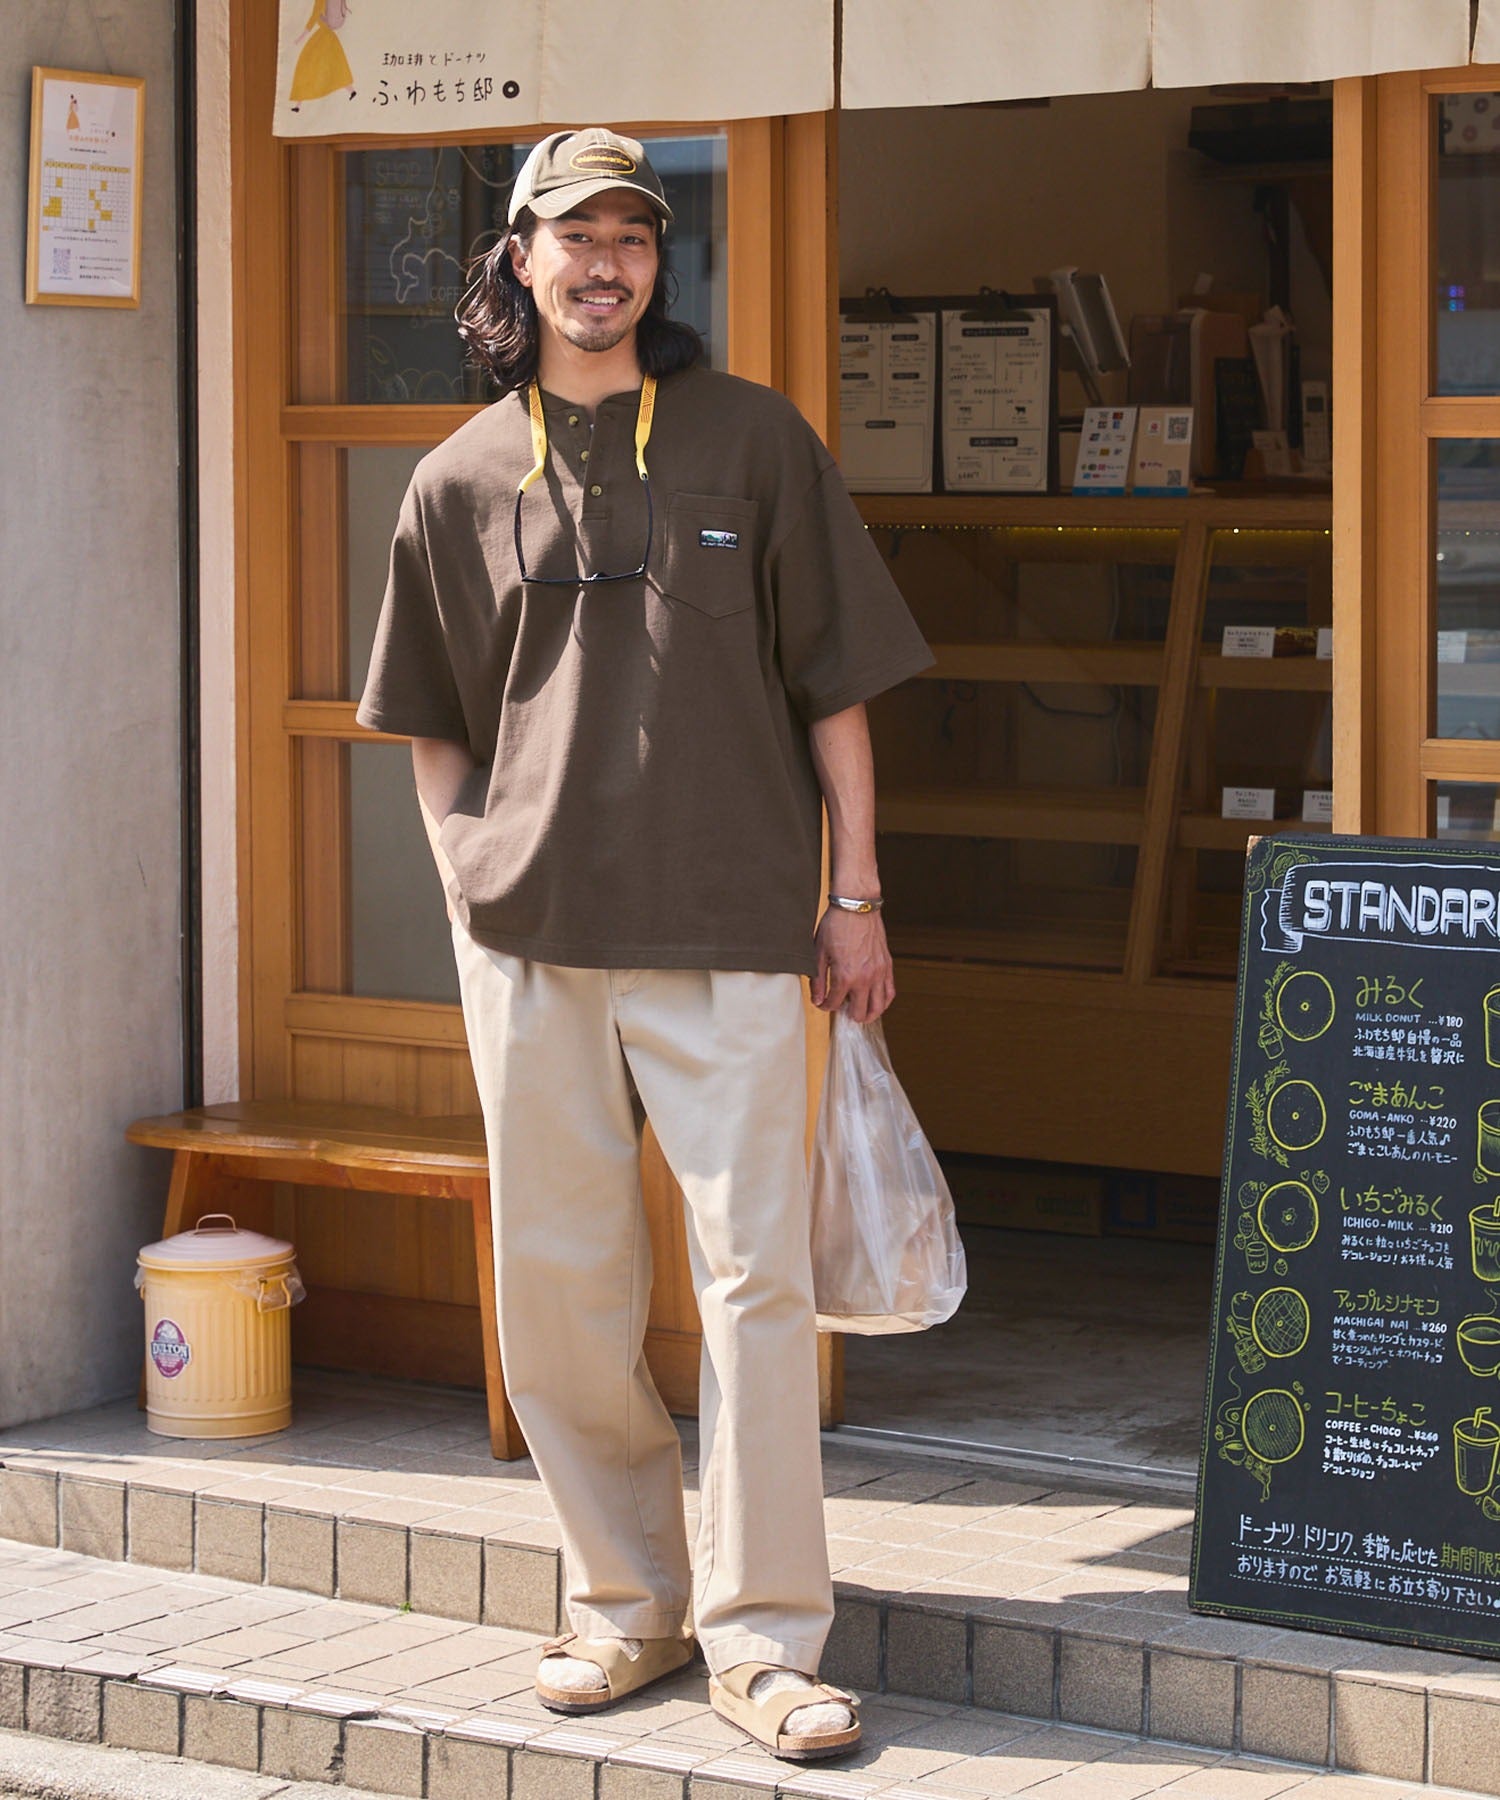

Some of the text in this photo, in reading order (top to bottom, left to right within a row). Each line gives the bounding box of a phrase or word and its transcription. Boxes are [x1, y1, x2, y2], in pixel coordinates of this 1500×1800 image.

[381, 52, 486, 66] 珈琲とドーナツ
[372, 77, 493, 106] ふわもち邸
[1303, 880, 1500, 939] STANDAR
[1355, 975, 1424, 1008] みるく
[1355, 1013, 1383, 1023] MILK
[1385, 1013, 1421, 1024] DONUT
[1349, 1080, 1445, 1110] ごまあんこ
[1340, 1184, 1443, 1221] いちごみるく
[1333, 1288, 1440, 1316] アップルシナモン
[1333, 1316, 1384, 1328] MACHIGAI
[1390, 1320, 1409, 1330] NAI
[1325, 1391, 1427, 1426] コーヒーちょこ
[1322, 1461, 1376, 1480] デコレーション
